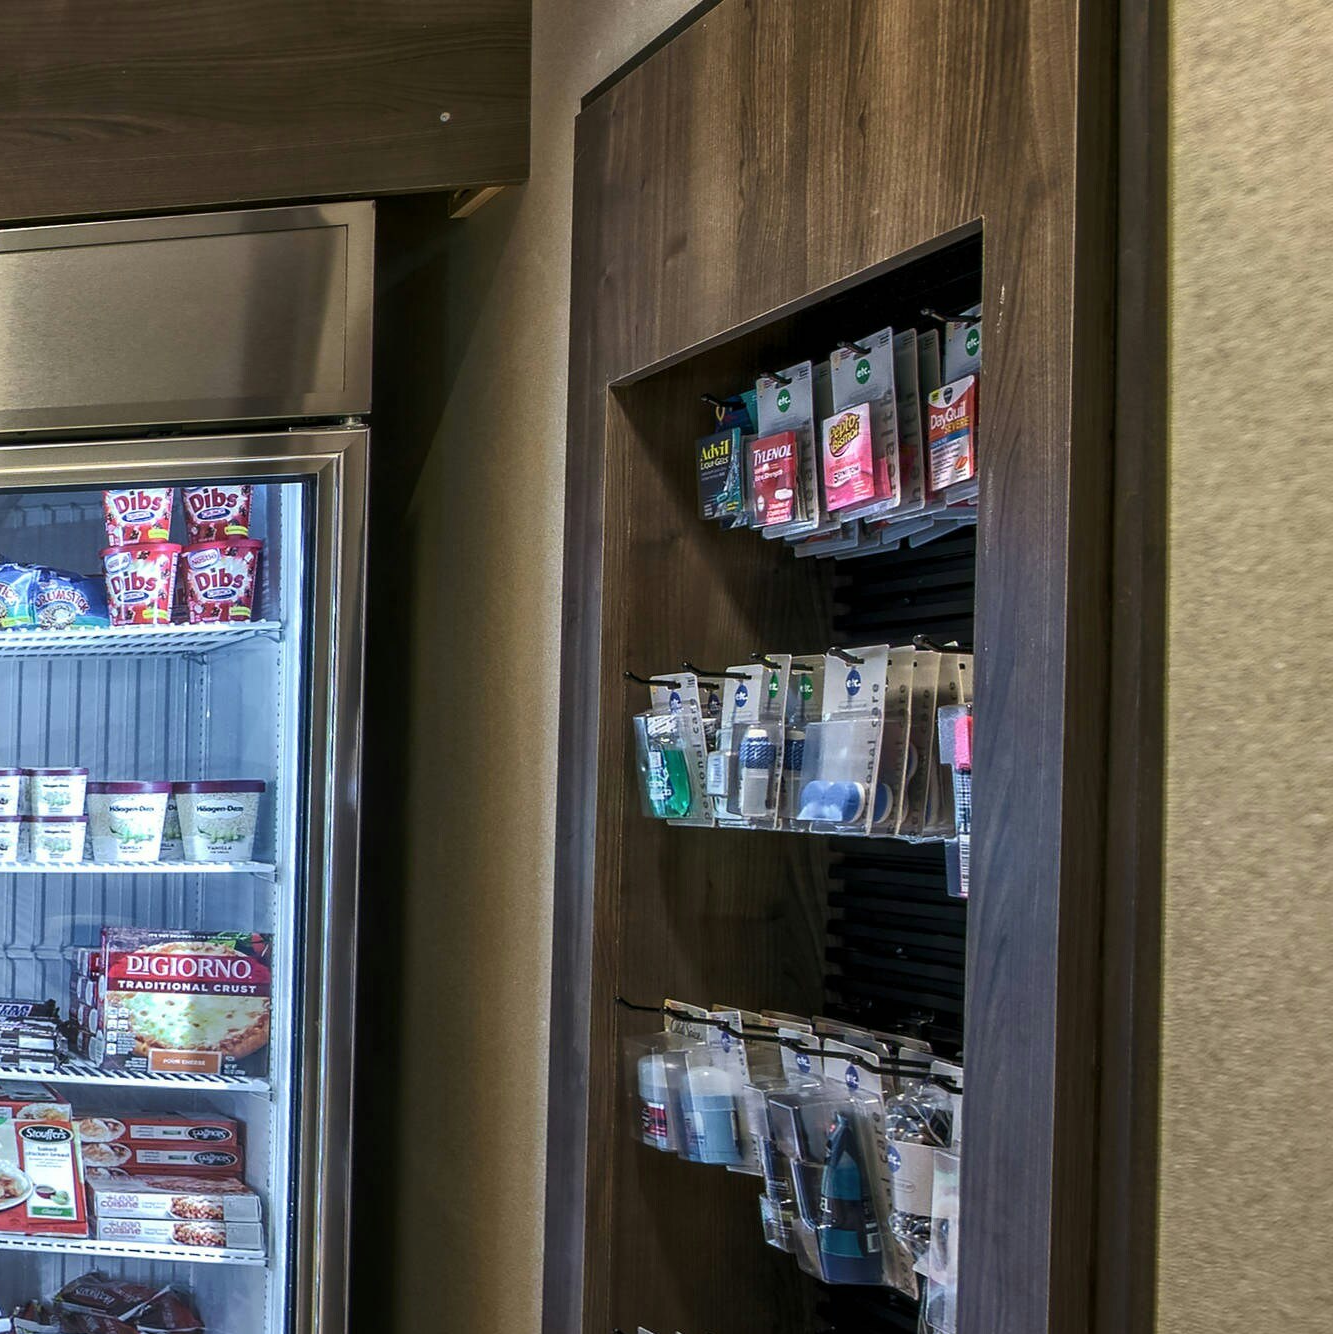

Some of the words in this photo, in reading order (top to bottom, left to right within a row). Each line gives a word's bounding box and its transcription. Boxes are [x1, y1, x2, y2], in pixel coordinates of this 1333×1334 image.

[855, 365, 871, 379] etc.
[930, 398, 966, 430] DayQuil
[699, 439, 729, 462] Advil
[753, 443, 793, 466] TYLENOL
[113, 489, 163, 515] Dibs
[189, 487, 239, 513] Dibs
[110, 571, 157, 596] Dibs
[195, 568, 245, 593] Dibs
[688, 697, 698, 735] care
[871, 683, 885, 728] care
[695, 744, 712, 821] personal
[196, 803, 244, 814] Häagen-Dazs
[117, 978, 209, 993] TRADITIONAL
[213, 981, 257, 994] CRUST
[24, 1127, 69, 1143] Stouffer's
